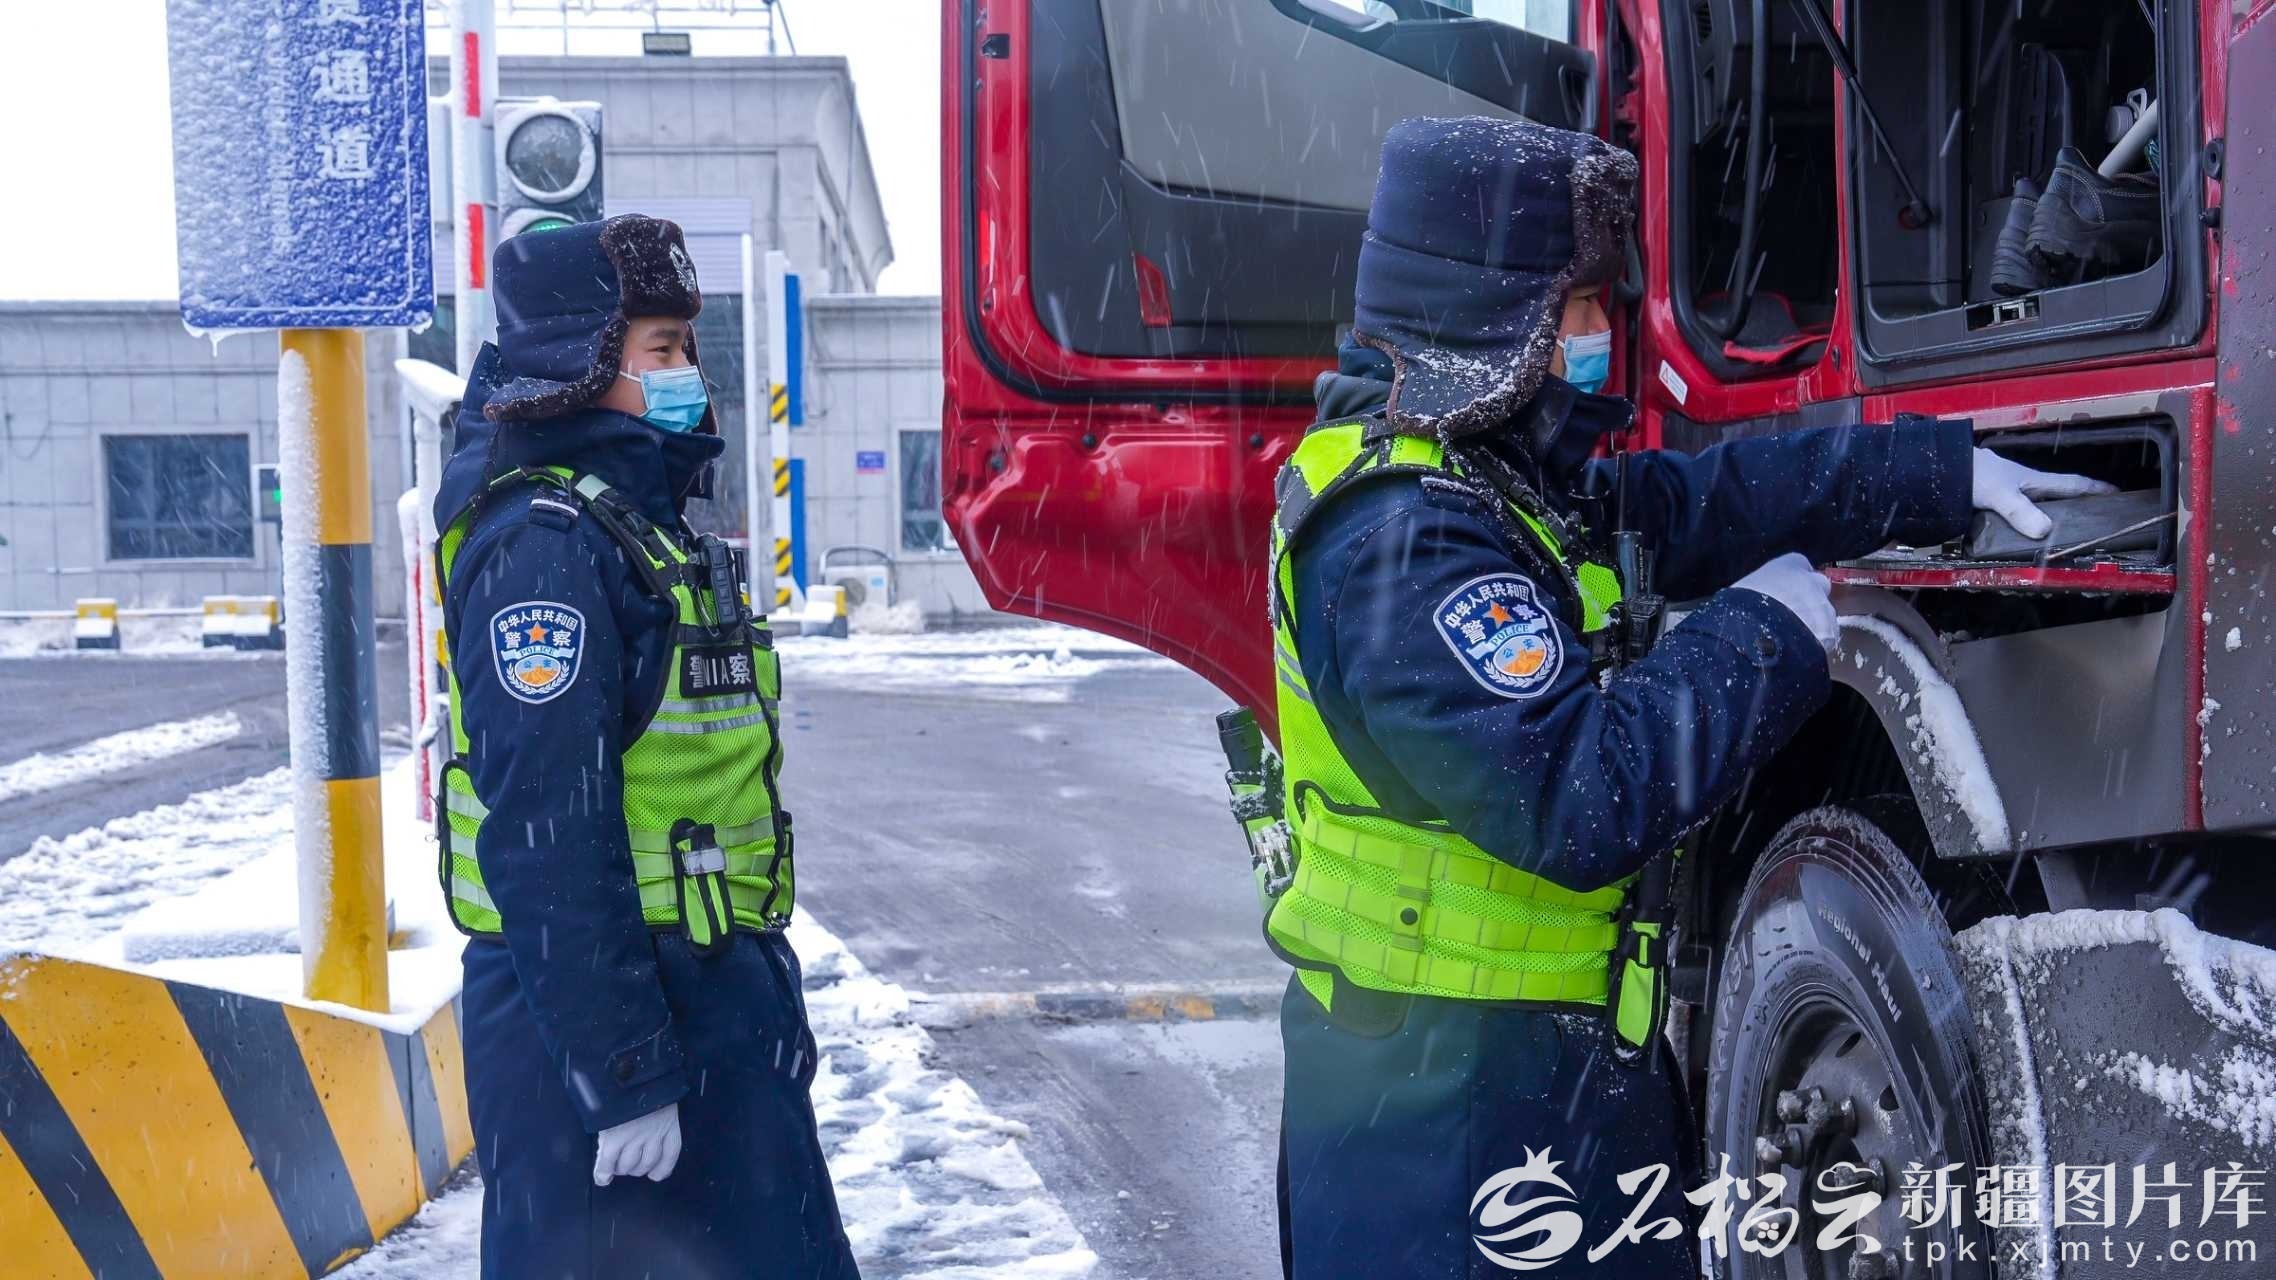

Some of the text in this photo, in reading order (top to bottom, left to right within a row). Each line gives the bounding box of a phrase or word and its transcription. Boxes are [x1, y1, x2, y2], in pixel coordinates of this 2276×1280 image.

[1444, 582, 1530, 629] 中华人民共和国
[498, 609, 579, 633] 中华人民共和国
[1490, 624, 1530, 646] POLICE
[519, 646, 557, 656] POLICE
